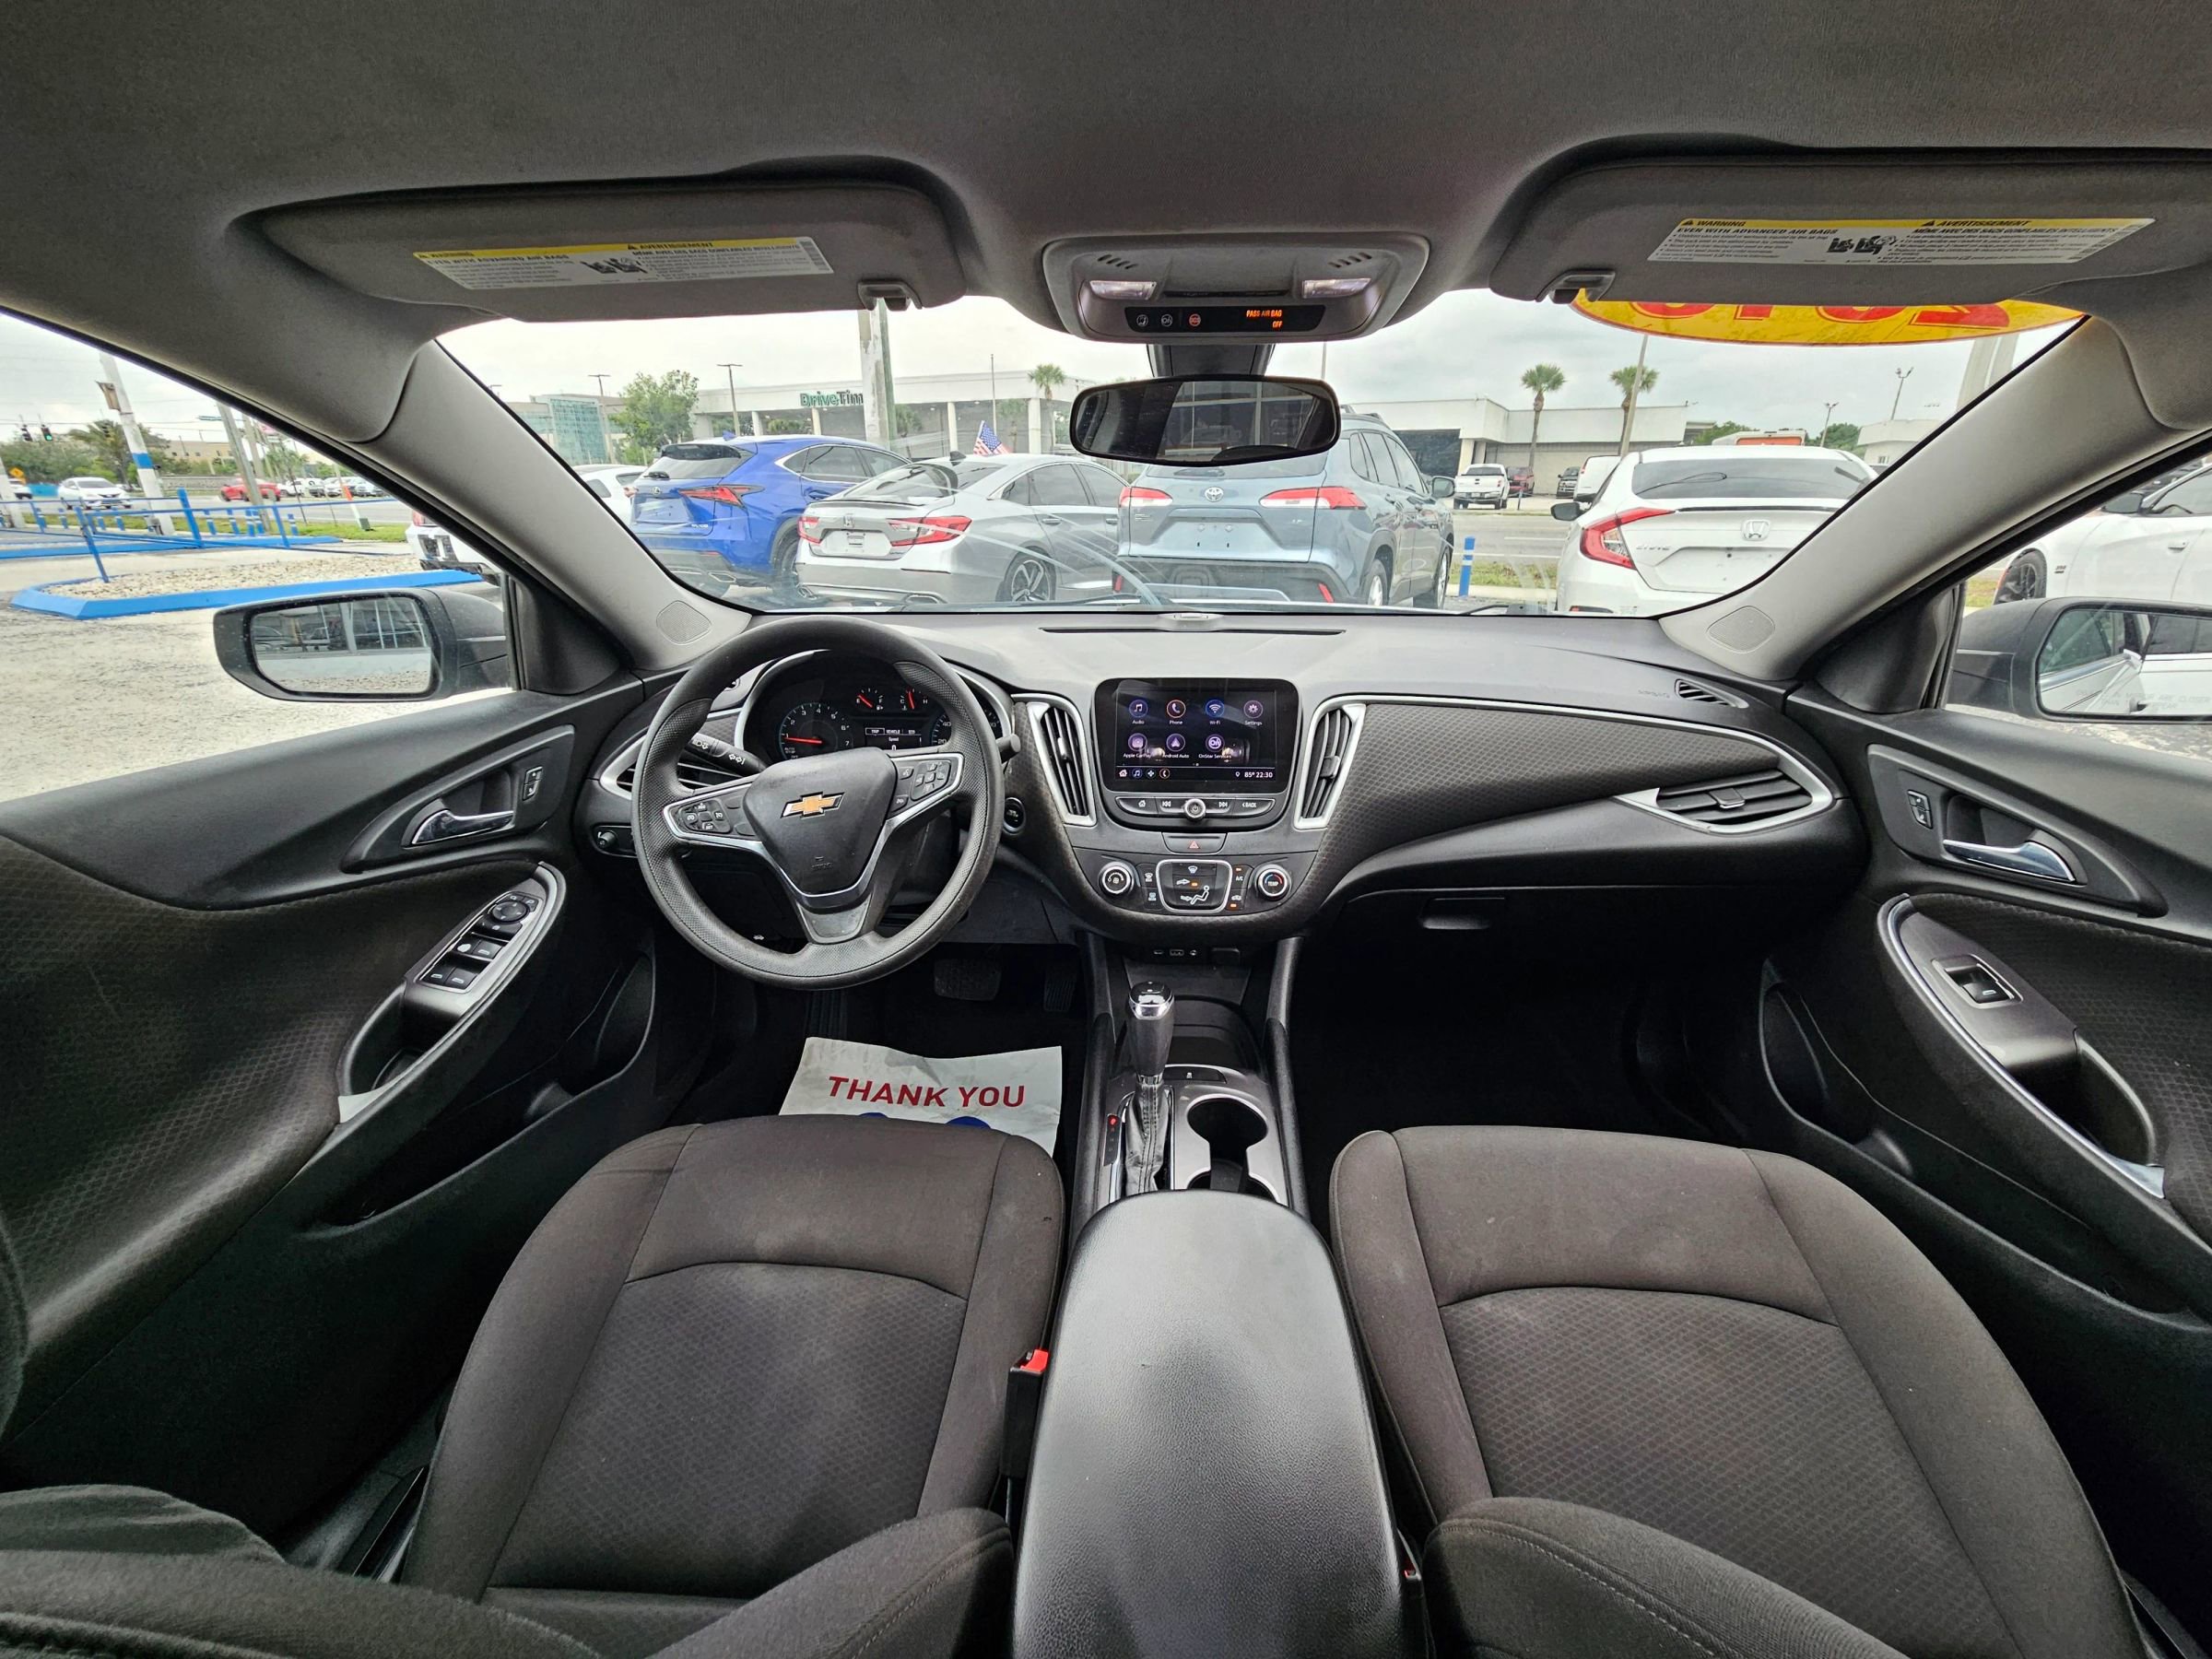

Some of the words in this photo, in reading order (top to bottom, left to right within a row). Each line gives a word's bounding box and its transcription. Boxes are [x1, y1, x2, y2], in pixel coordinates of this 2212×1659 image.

[1246, 310, 1260, 318] PASS
[800, 390, 864, 406] DriveTim
[830, 1076, 949, 1107] THANK
[958, 1085, 1025, 1107] YOU
